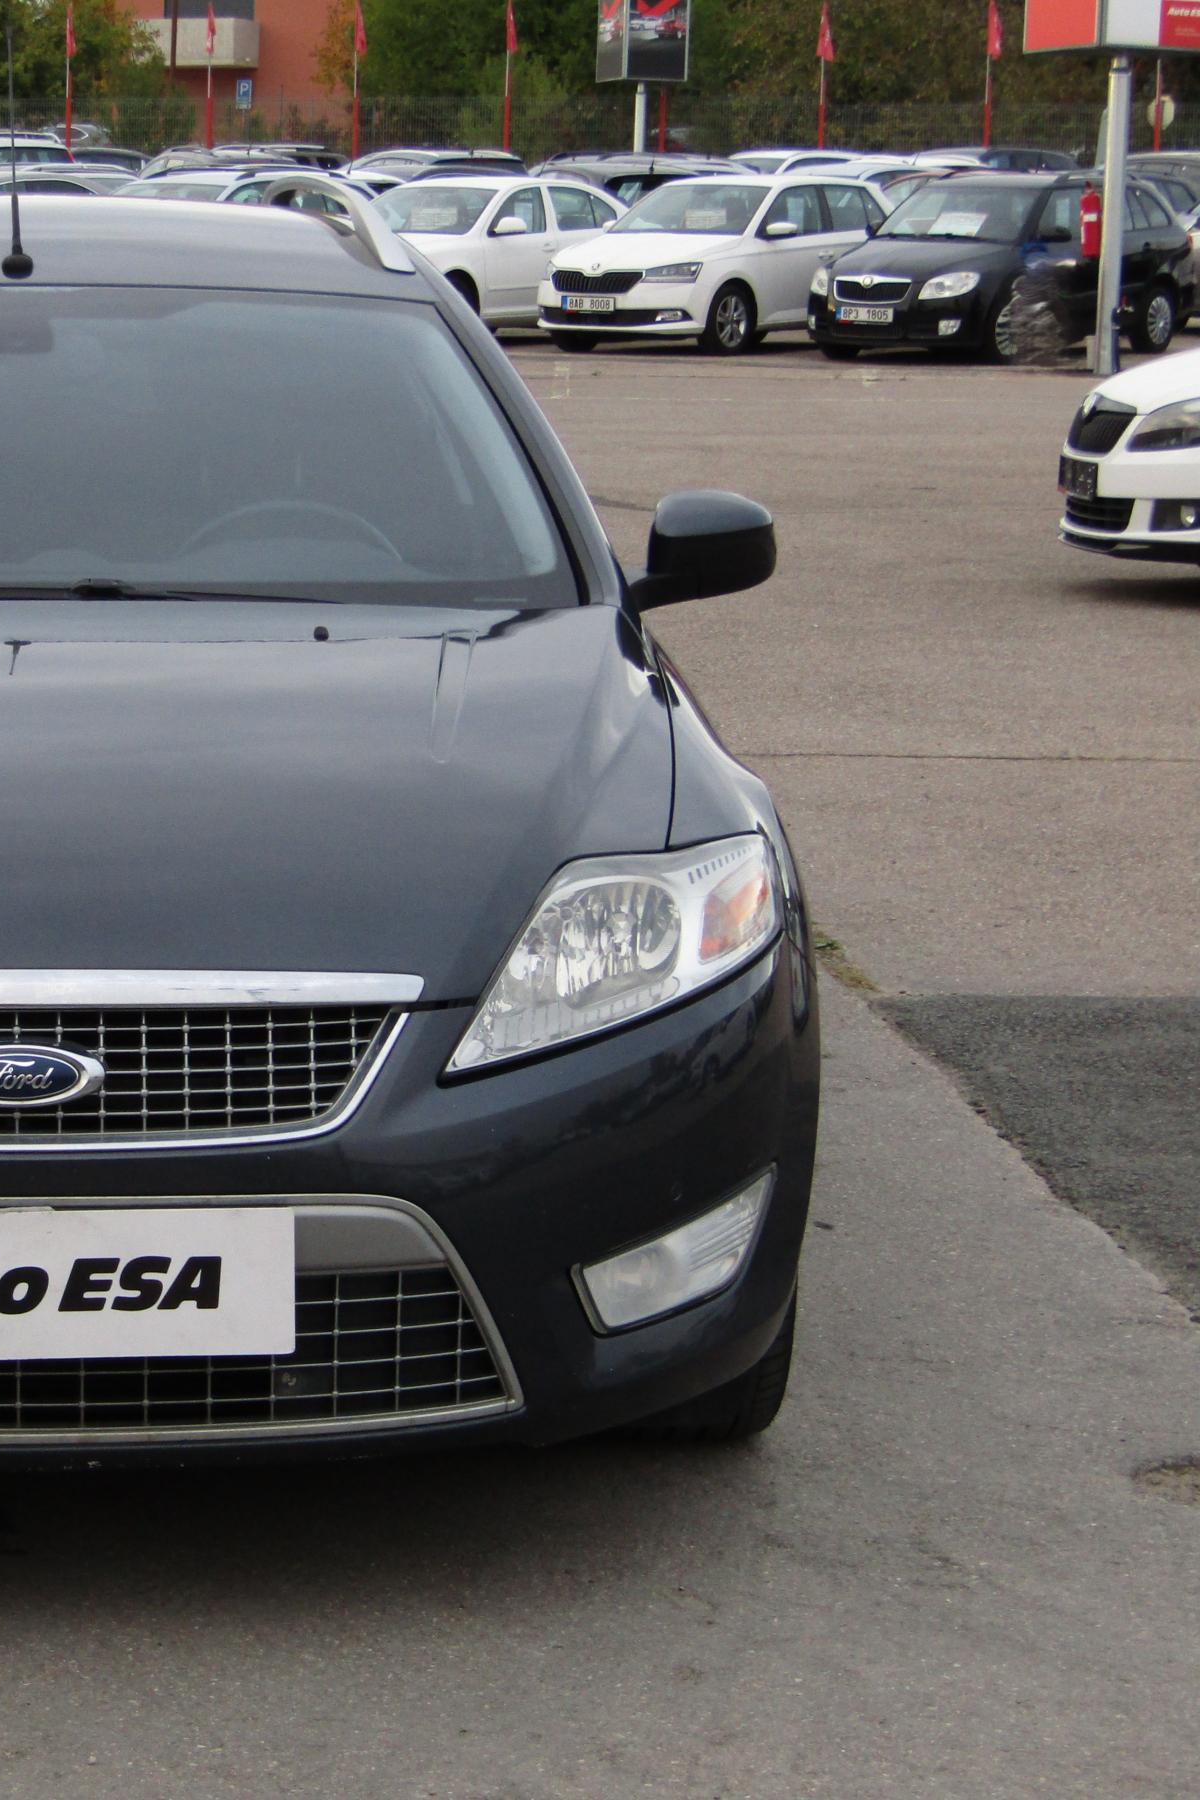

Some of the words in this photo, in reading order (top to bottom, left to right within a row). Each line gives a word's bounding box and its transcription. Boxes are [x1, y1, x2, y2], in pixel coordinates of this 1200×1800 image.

[240, 82, 249, 96] P
[569, 298, 583, 308] 8AB
[590, 299, 610, 310] 8008
[866, 308, 888, 320] 1805
[58, 1256, 222, 1312] ESA
